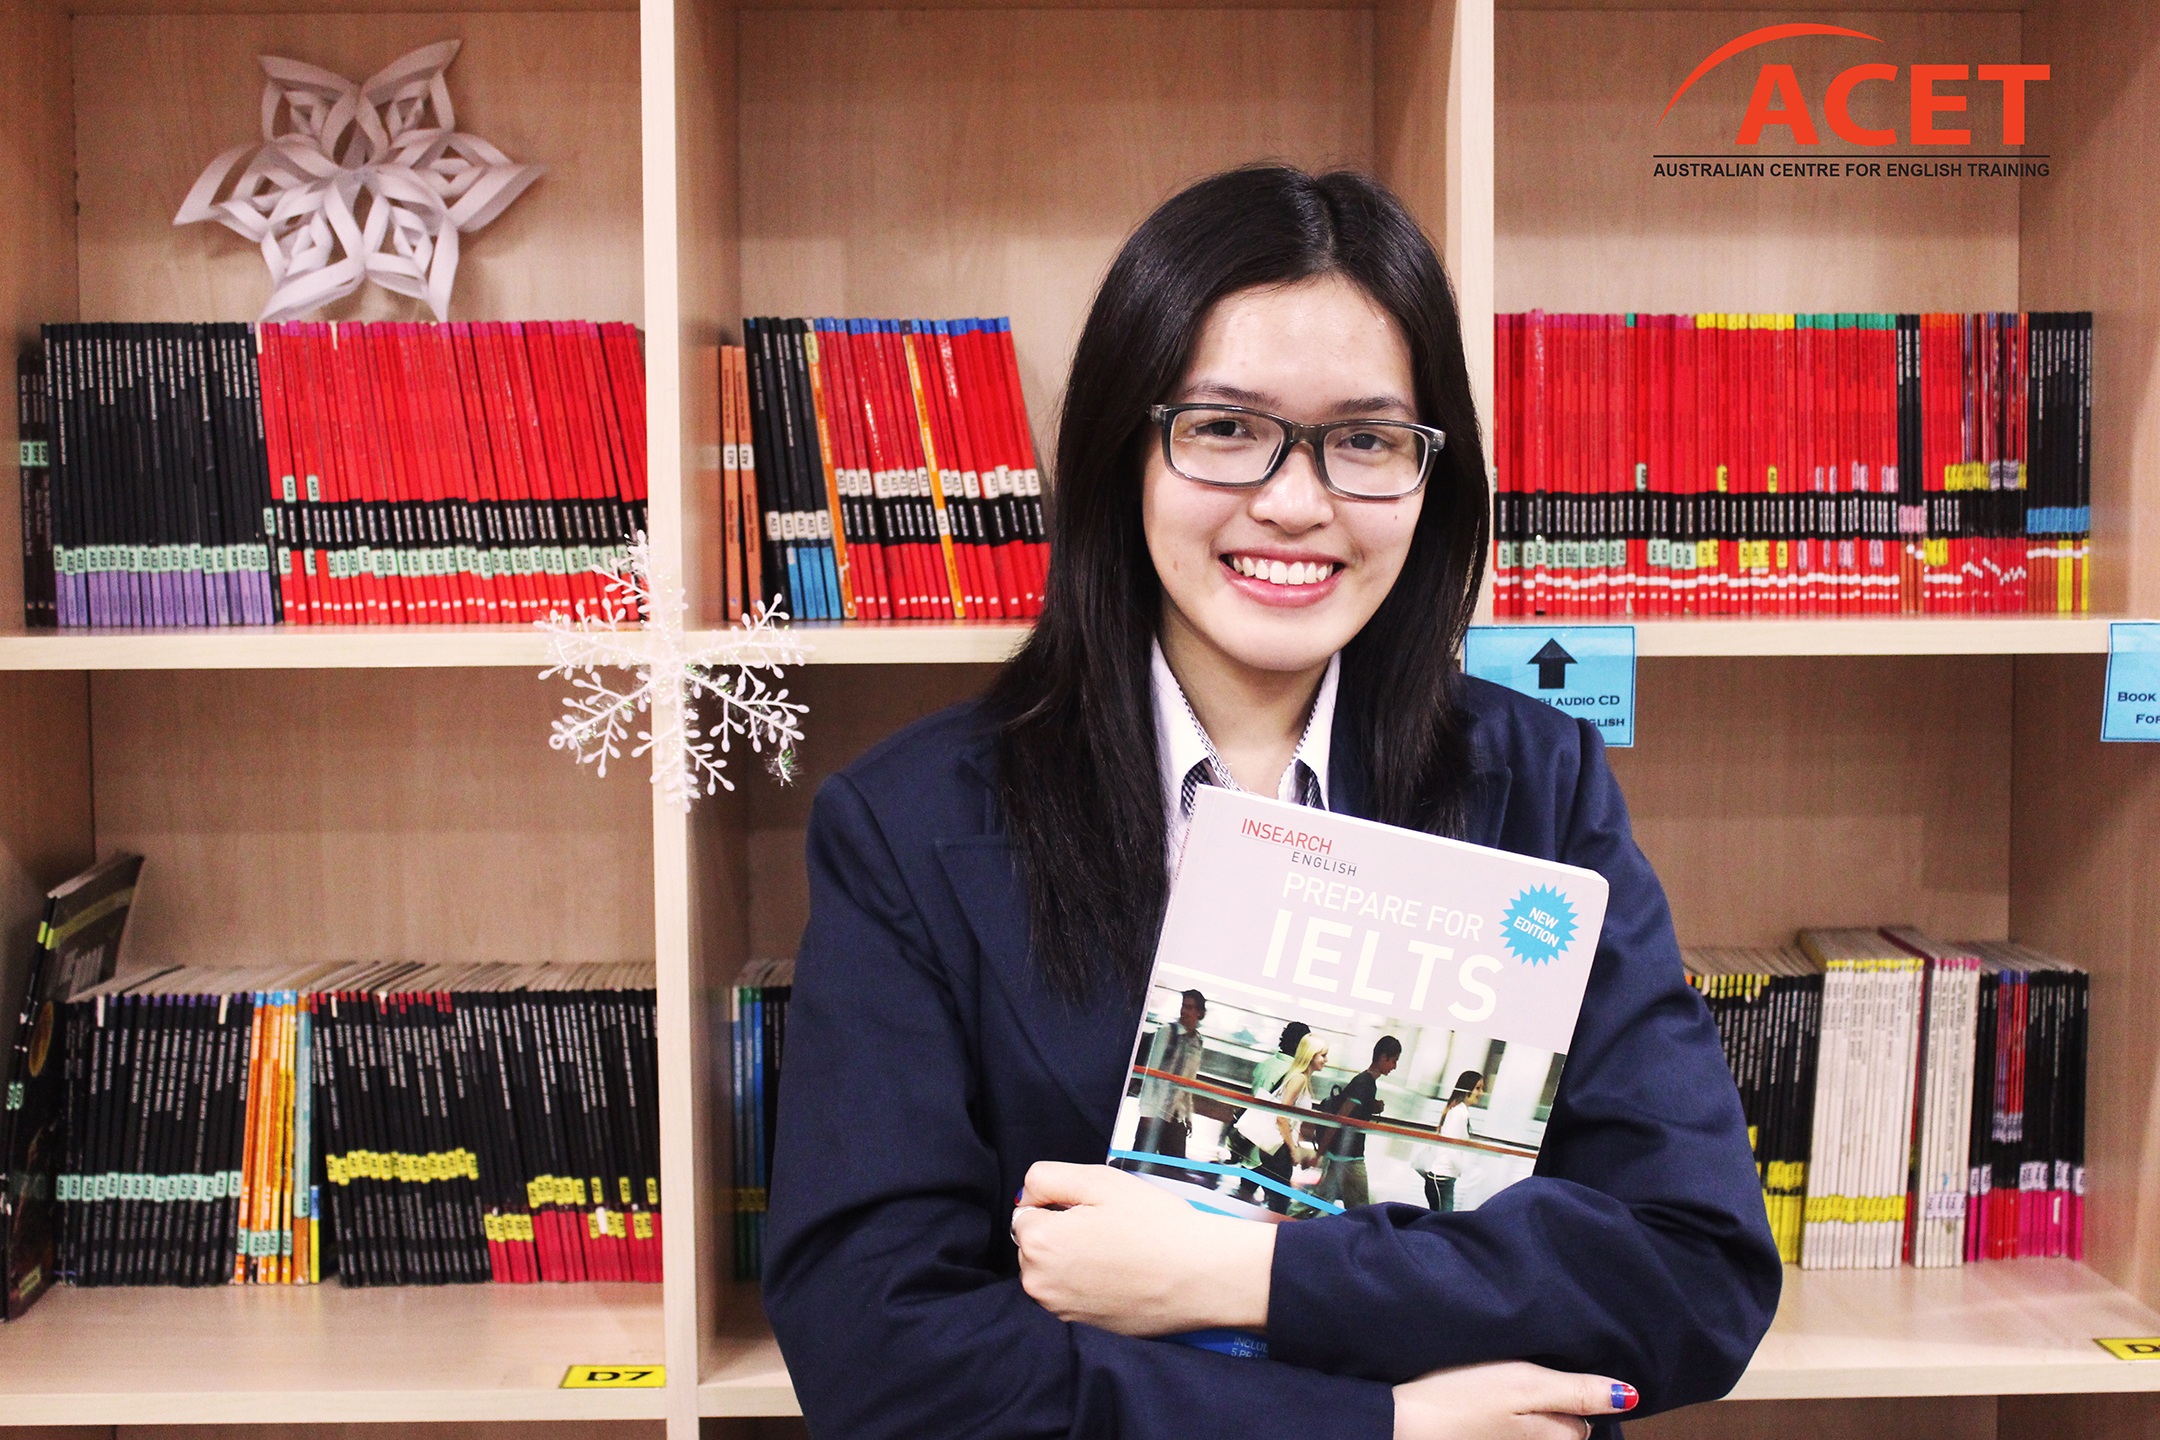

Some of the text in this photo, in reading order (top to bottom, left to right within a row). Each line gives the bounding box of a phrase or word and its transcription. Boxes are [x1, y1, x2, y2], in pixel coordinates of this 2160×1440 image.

[1555, 697, 1595, 706] AUDIO
[1598, 695, 1620, 706] CD
[1241, 818, 1333, 855] INSEARCH
[1291, 851, 1357, 877] ENGLISH
[1282, 871, 1484, 942] PREPARE FOR
[1528, 906, 1559, 929] NEW
[1513, 915, 1560, 948] EDITION
[1261, 908, 1505, 1023] IELTS
[586, 1371, 653, 1382] D7
